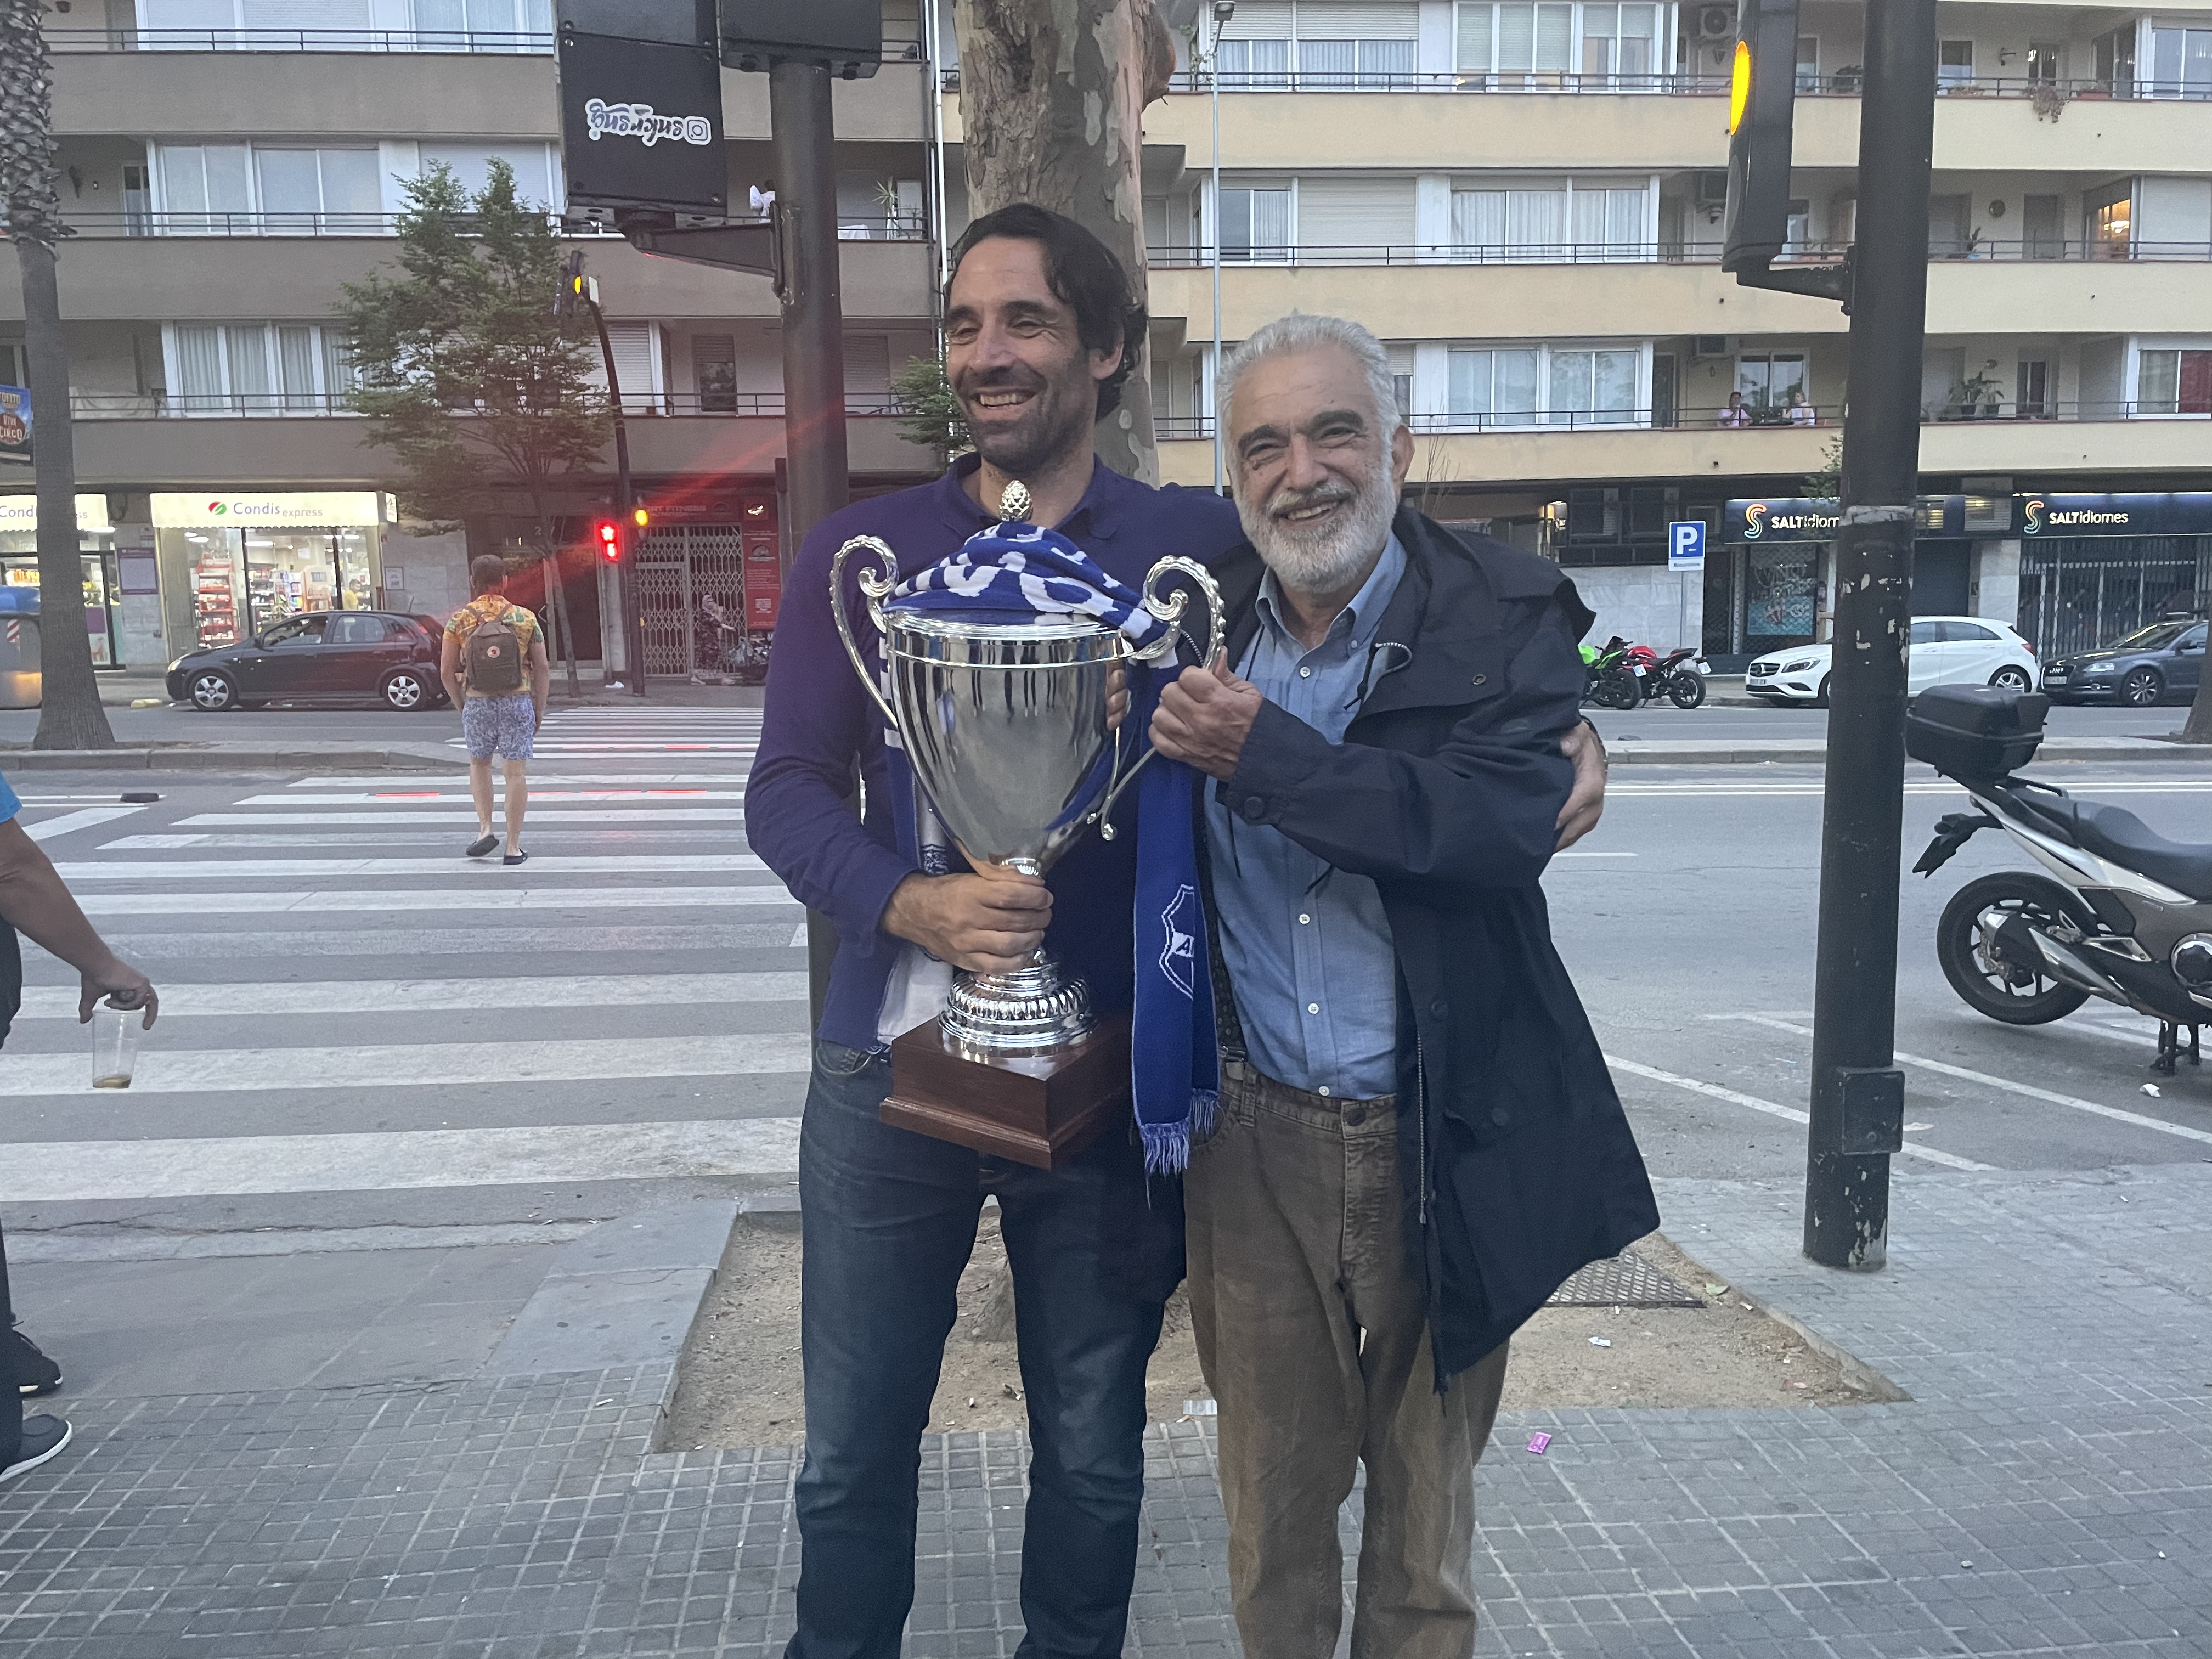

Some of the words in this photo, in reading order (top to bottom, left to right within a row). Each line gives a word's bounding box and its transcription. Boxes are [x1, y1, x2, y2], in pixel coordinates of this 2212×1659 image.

[0, 392, 20, 405] OFITO
[0, 505, 33, 517] Cond
[233, 502, 280, 515] Condis
[283, 508, 323, 518] express
[2049, 510, 2129, 524] SALTidiomes
[1771, 514, 1839, 529] SALTidiom
[1677, 526, 1698, 554] P
